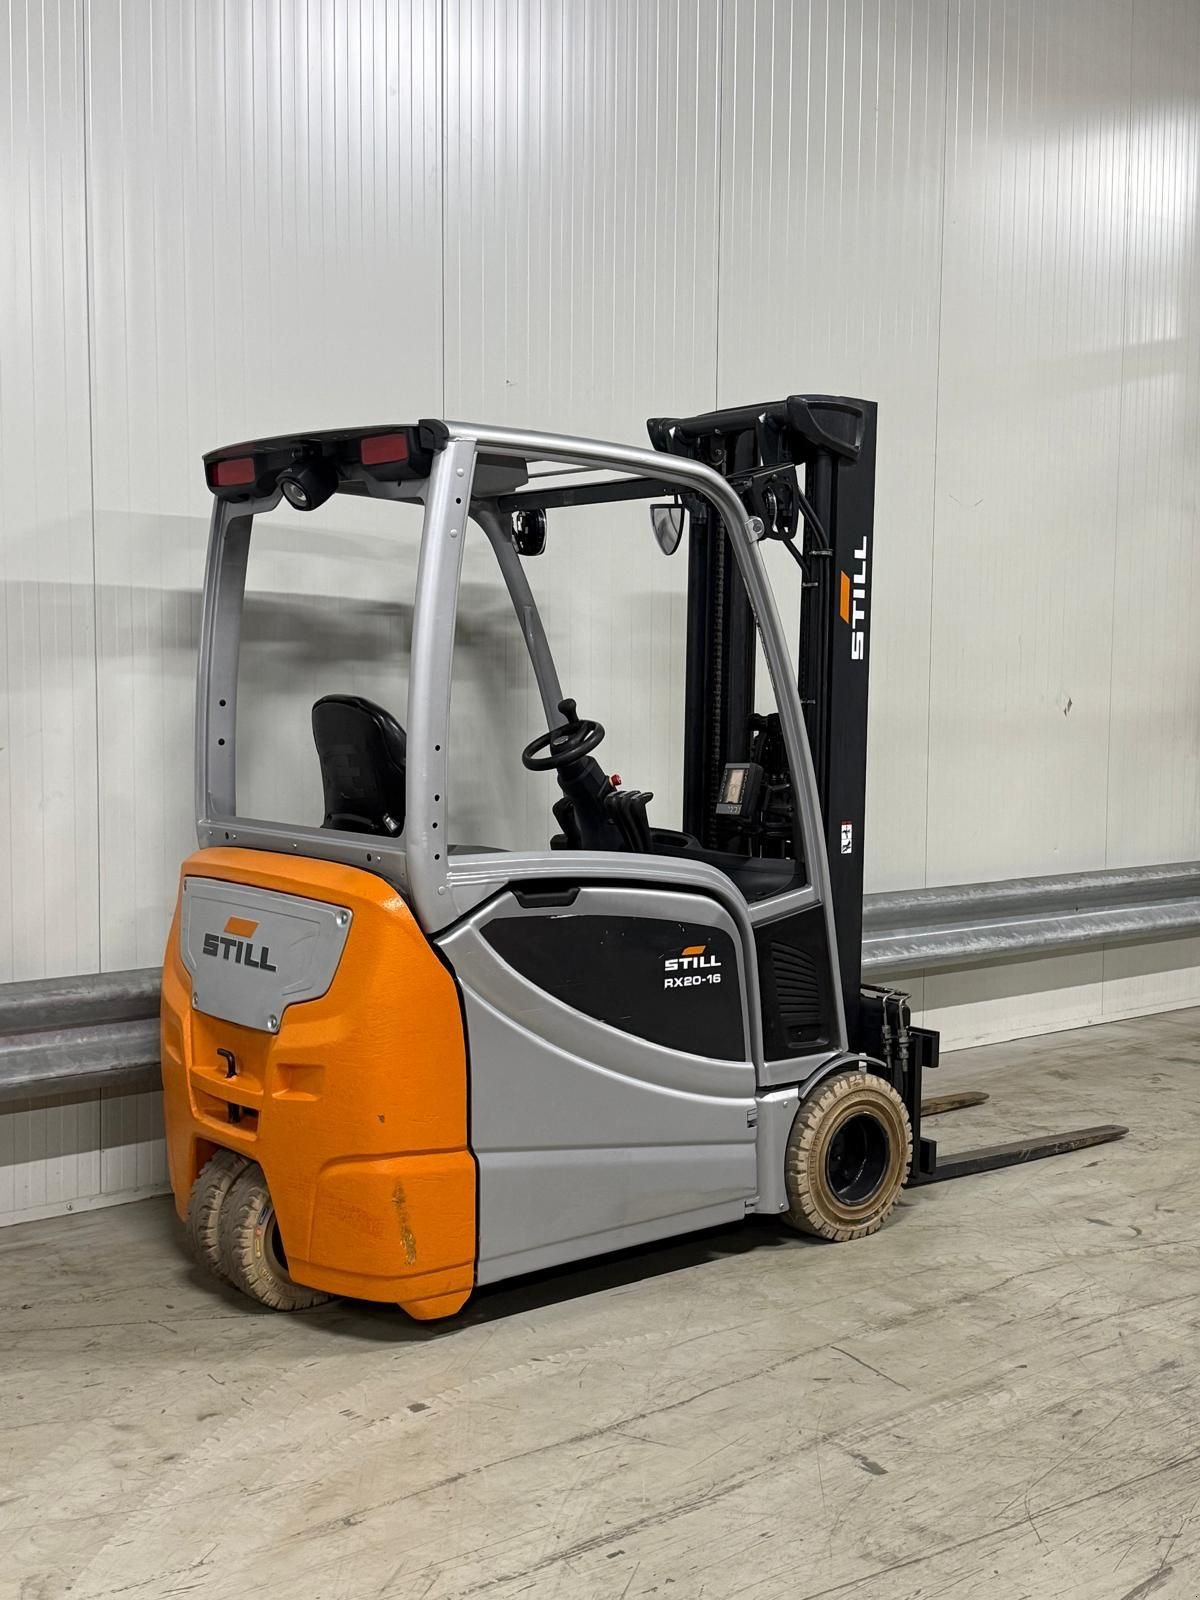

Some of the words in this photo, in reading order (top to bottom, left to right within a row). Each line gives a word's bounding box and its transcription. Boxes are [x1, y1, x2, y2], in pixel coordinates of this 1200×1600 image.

[851, 536, 867, 660] STILL
[203, 932, 277, 972] STILL
[664, 955, 722, 972] STILL
[664, 974, 721, 989] RX20-16
